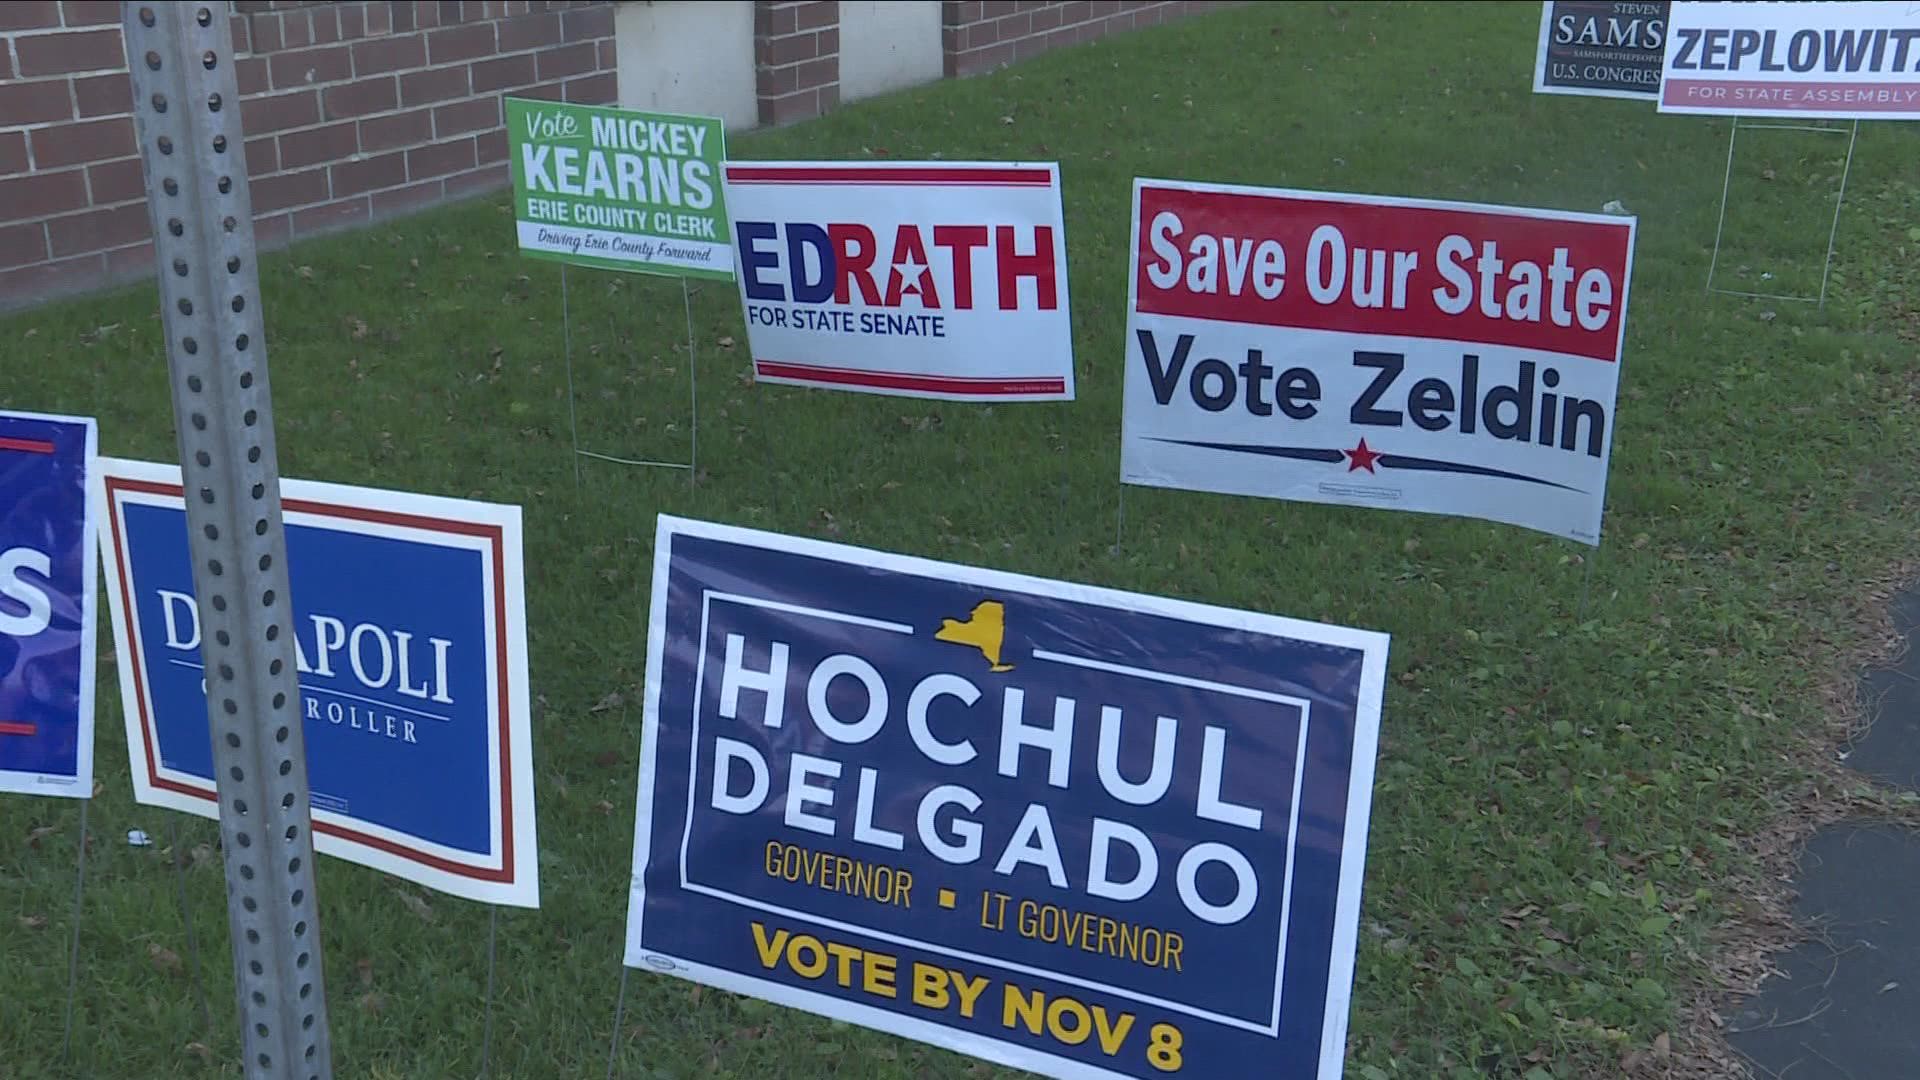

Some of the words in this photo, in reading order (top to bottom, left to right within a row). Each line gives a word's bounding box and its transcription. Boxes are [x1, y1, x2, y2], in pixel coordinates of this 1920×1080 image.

[1613, 3, 1660, 15] STEVEN
[1555, 15, 1664, 49] SAMS
[1671, 28, 1920, 73] ZEPLOWIT
[1553, 63, 1580, 79] U.S.
[1583, 64, 1661, 84] CONGRES
[1687, 86, 1727, 98] FOR
[1735, 88, 1794, 100] STATE
[1803, 89, 1918, 102] ASSEMBLY
[526, 110, 584, 141] Vote
[591, 116, 706, 157] MICKEY
[522, 143, 713, 210] KEARNS
[527, 198, 569, 222] ERIE
[574, 203, 647, 230] COUNTY
[654, 212, 716, 238] CLERK
[537, 228, 581, 250] Driving
[585, 234, 609, 250] Erie
[612, 237, 653, 261] County
[656, 243, 711, 262] Forward
[1146, 211, 1286, 300] Save
[1305, 224, 1418, 310] Our
[1432, 233, 1613, 331] State
[749, 305, 788, 328] FOR
[792, 309, 855, 332] STATE
[860, 314, 946, 337] SENATE
[1136, 329, 1321, 420] Vote
[1349, 350, 1606, 458] Zeldin
[718, 633, 1262, 830] HOCHUL
[711, 736, 1259, 925] DELGADO
[765, 840, 913, 908] GOVERNOR
[981, 890, 1006, 931] LT
[1018, 900, 1184, 972] GOVERNOR
[750, 922, 898, 998] VOTE
[911, 962, 990, 1019] BY
[1002, 990, 1136, 1057] NOV
[1146, 1024, 1184, 1072] 8
